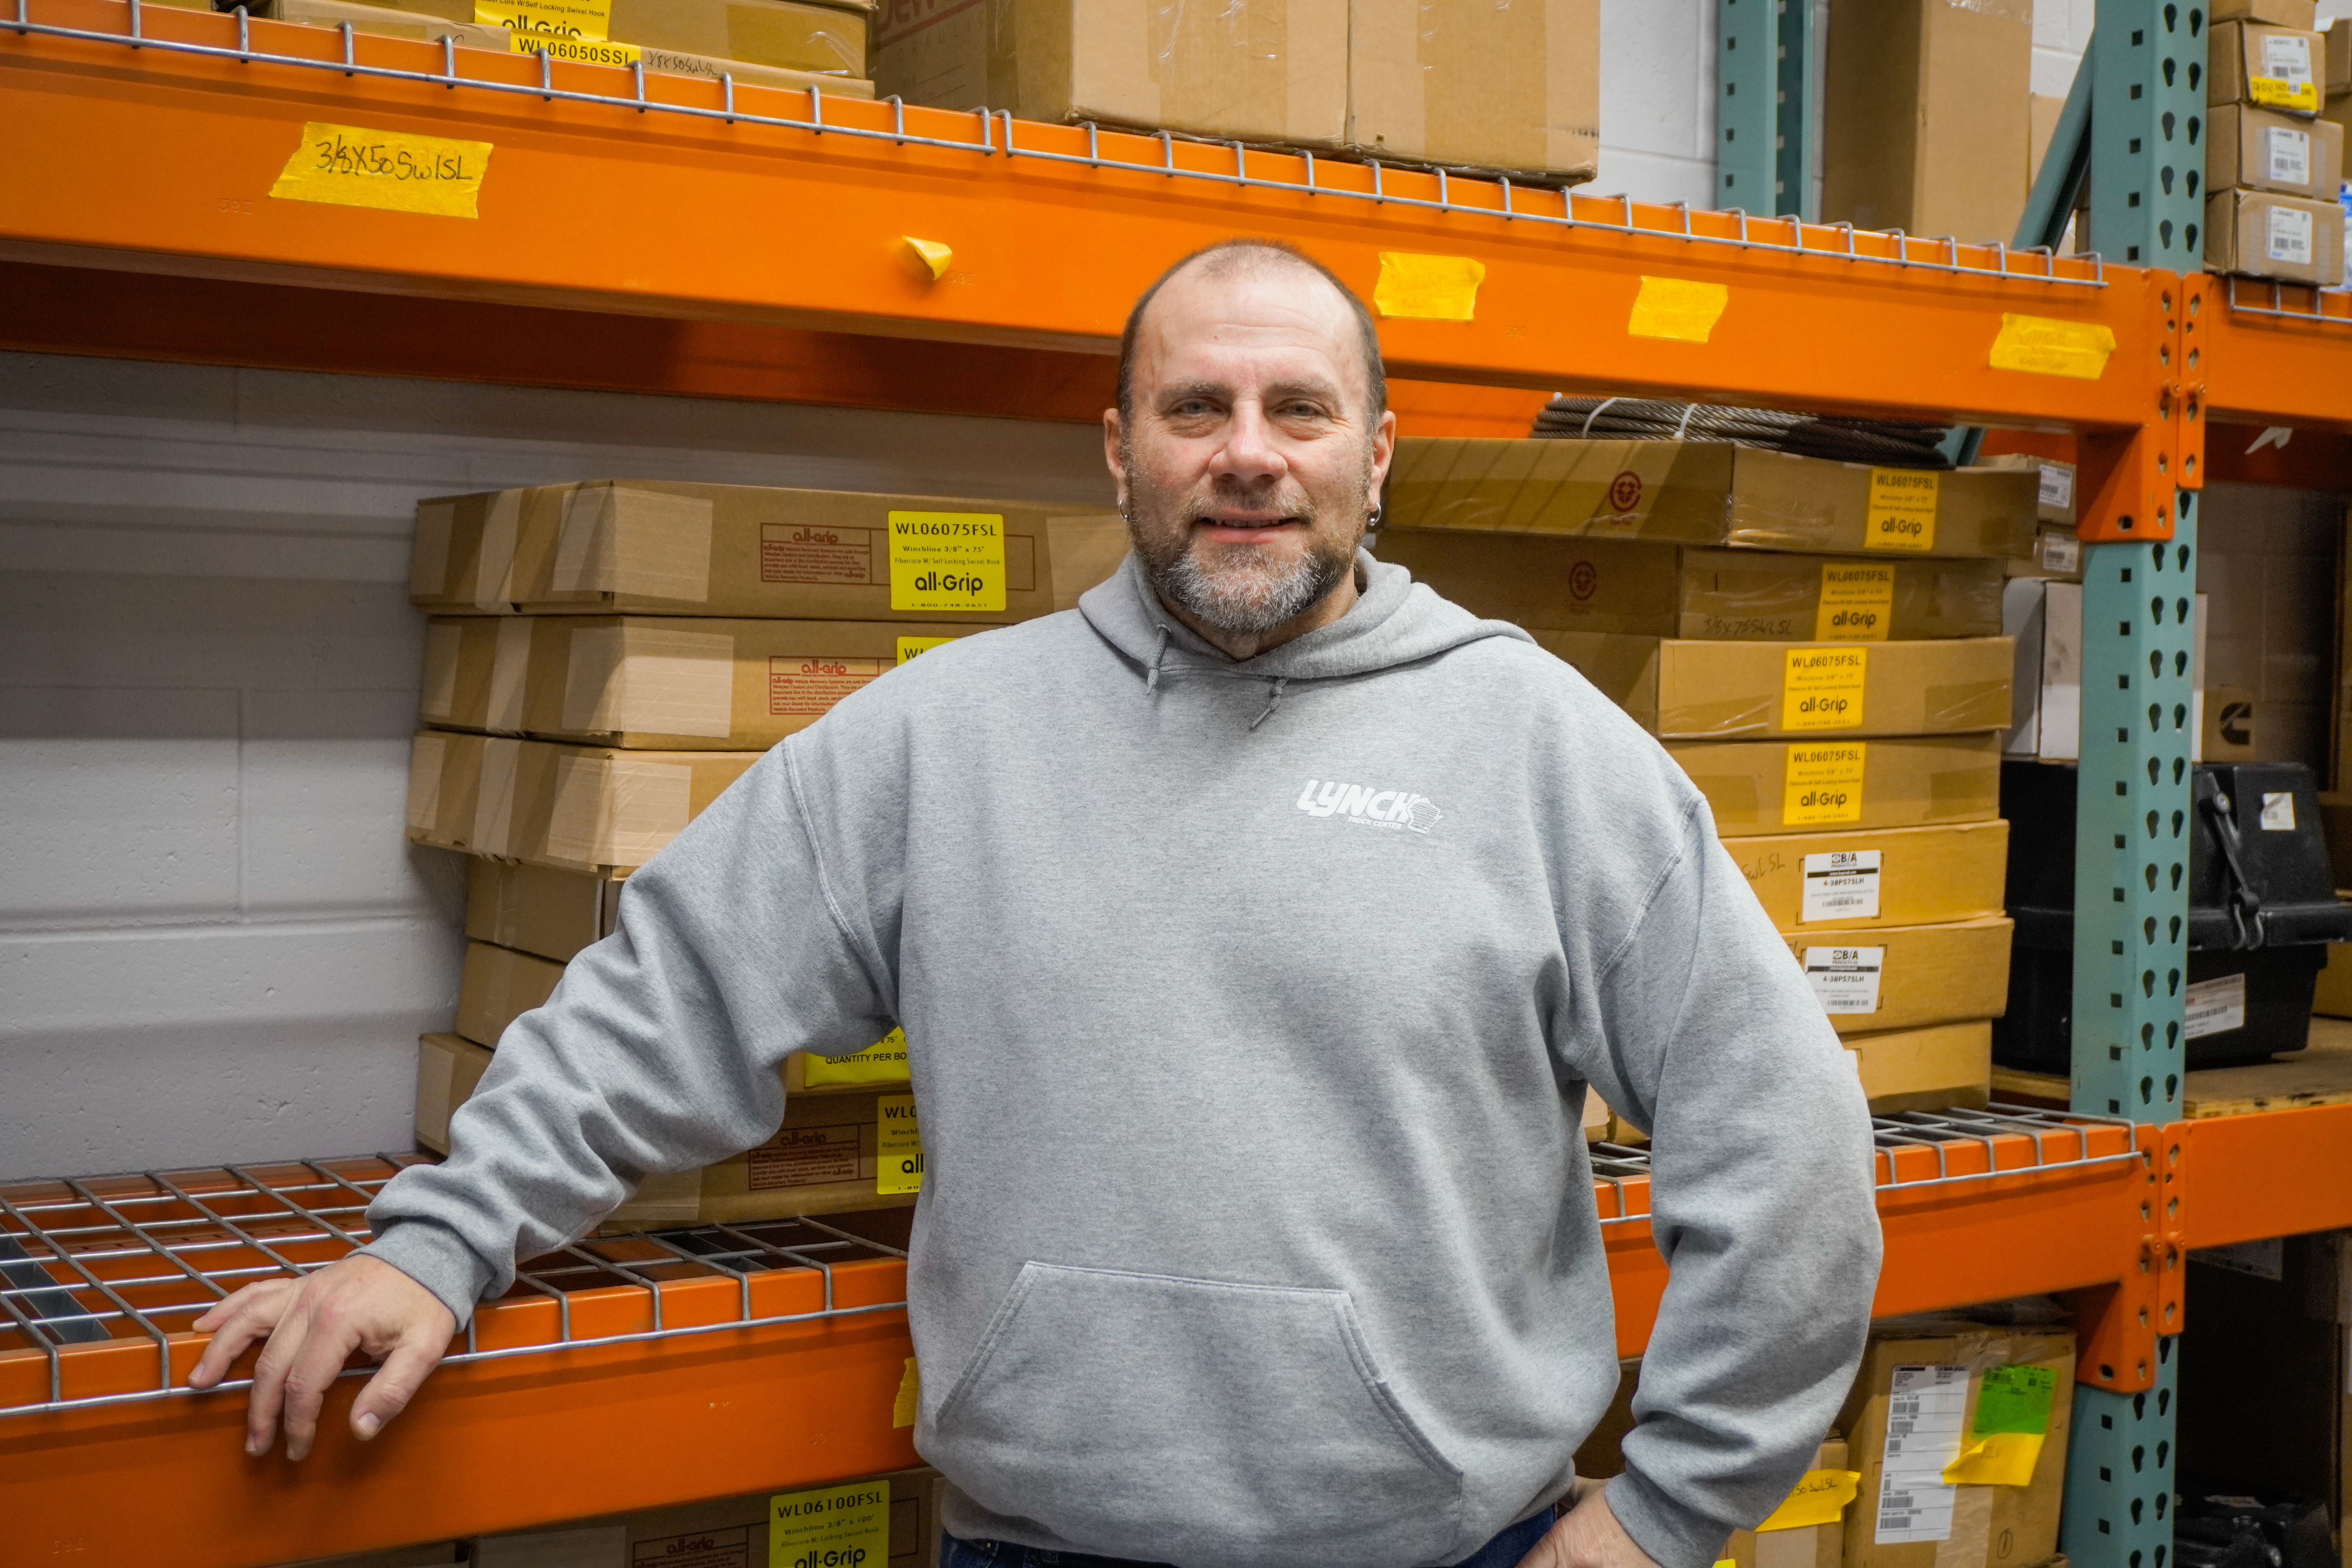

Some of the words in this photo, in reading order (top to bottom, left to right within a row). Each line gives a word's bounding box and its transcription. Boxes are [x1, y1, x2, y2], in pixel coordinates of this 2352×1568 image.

[539, 2, 564, 13] Locking
[567, 6, 587, 15] Swivel
[895, 522, 997, 536] WL06075FSL
[1793, 655, 1861, 668] WL06075FSL
[1794, 750, 1860, 762] WL06075FSL
[1348, 816, 1372, 826] TRUCK
[1373, 820, 1403, 830] CENTER
[1823, 877, 1864, 886] 4-38PS75LH
[826, 1054, 871, 1065] QUANTITY
[873, 1053, 891, 1062] PER
[778, 1491, 883, 1518] WL06100FSL
[784, 1524, 824, 1535] Winchline
